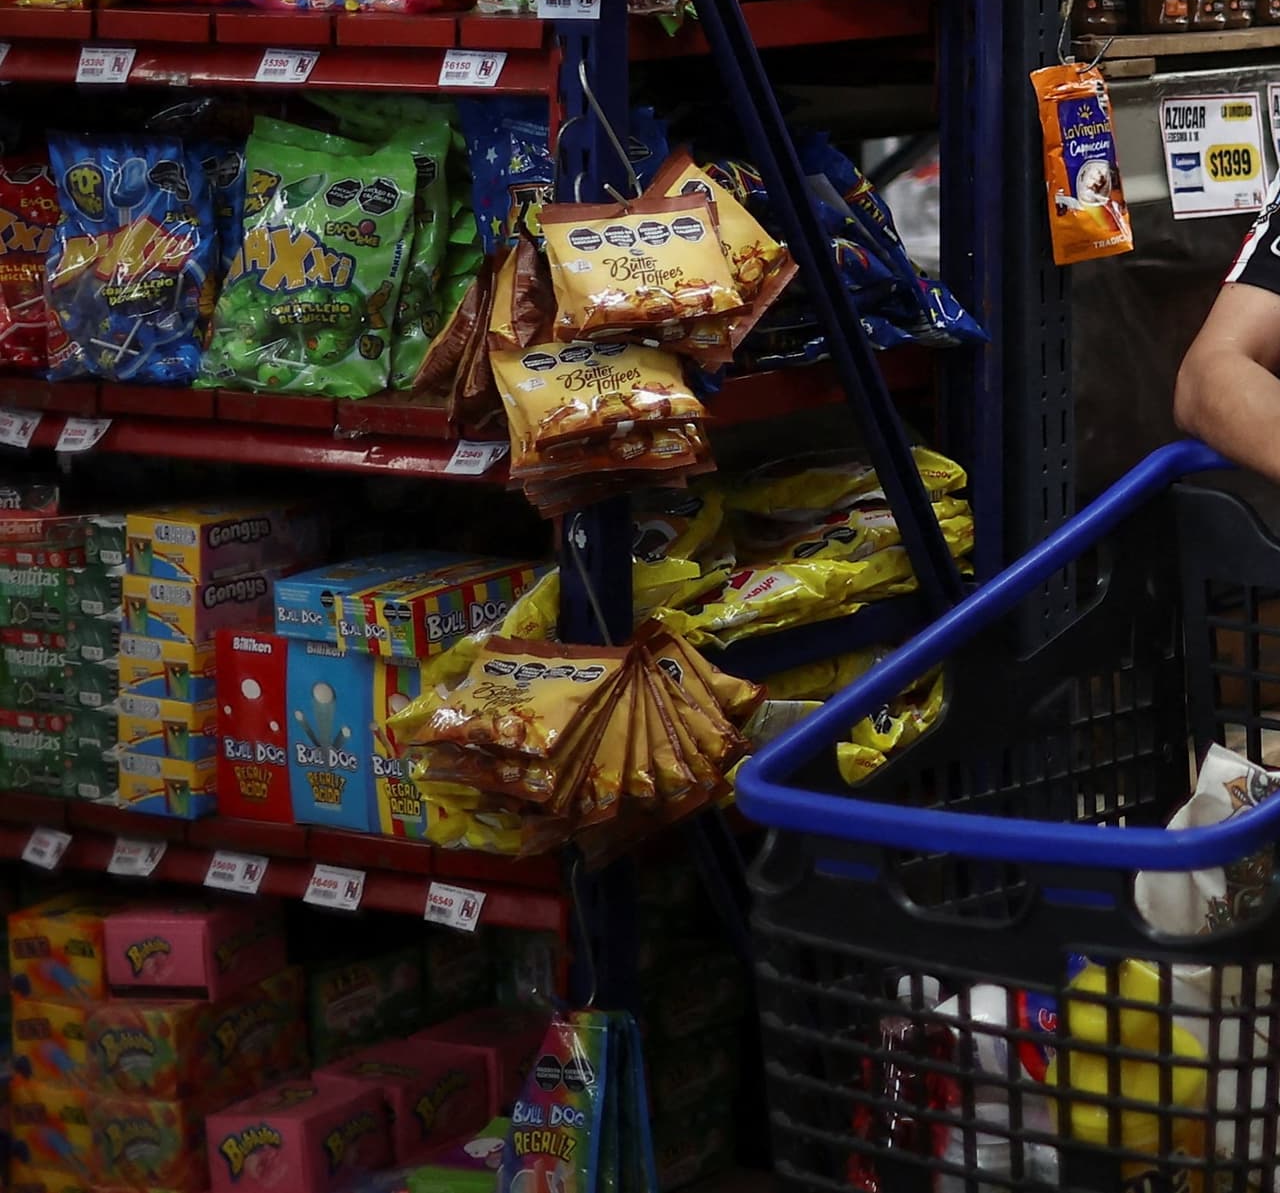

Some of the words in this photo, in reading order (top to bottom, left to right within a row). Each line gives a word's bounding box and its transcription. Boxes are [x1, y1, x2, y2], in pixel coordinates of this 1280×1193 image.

[445, 60, 471, 70] $6150
[1165, 106, 1206, 129] AZUCAR
[1210, 149, 1252, 178] $1399
[208, 517, 271, 548] Gongys
[203, 575, 267, 608] Gongys
[278, 607, 301, 624] BULL
[302, 610, 322, 625] DOG
[340, 620, 363, 637] BULL
[364, 623, 388, 638] DOG
[426, 614, 467, 641] BULL
[471, 601, 508, 627] DOG
[233, 636, 272, 654] Billiken
[224, 739, 254, 760] BULL
[255, 743, 287, 766] DOG
[296, 744, 325, 766] BULL
[327, 750, 358, 771] DOG
[372, 757, 402, 778] BULL
[428, 893, 454, 907] $6549
[512, 1101, 547, 1128] BULL
[548, 1104, 586, 1128] DOG
[513, 1131, 576, 1163] REGALIZ
